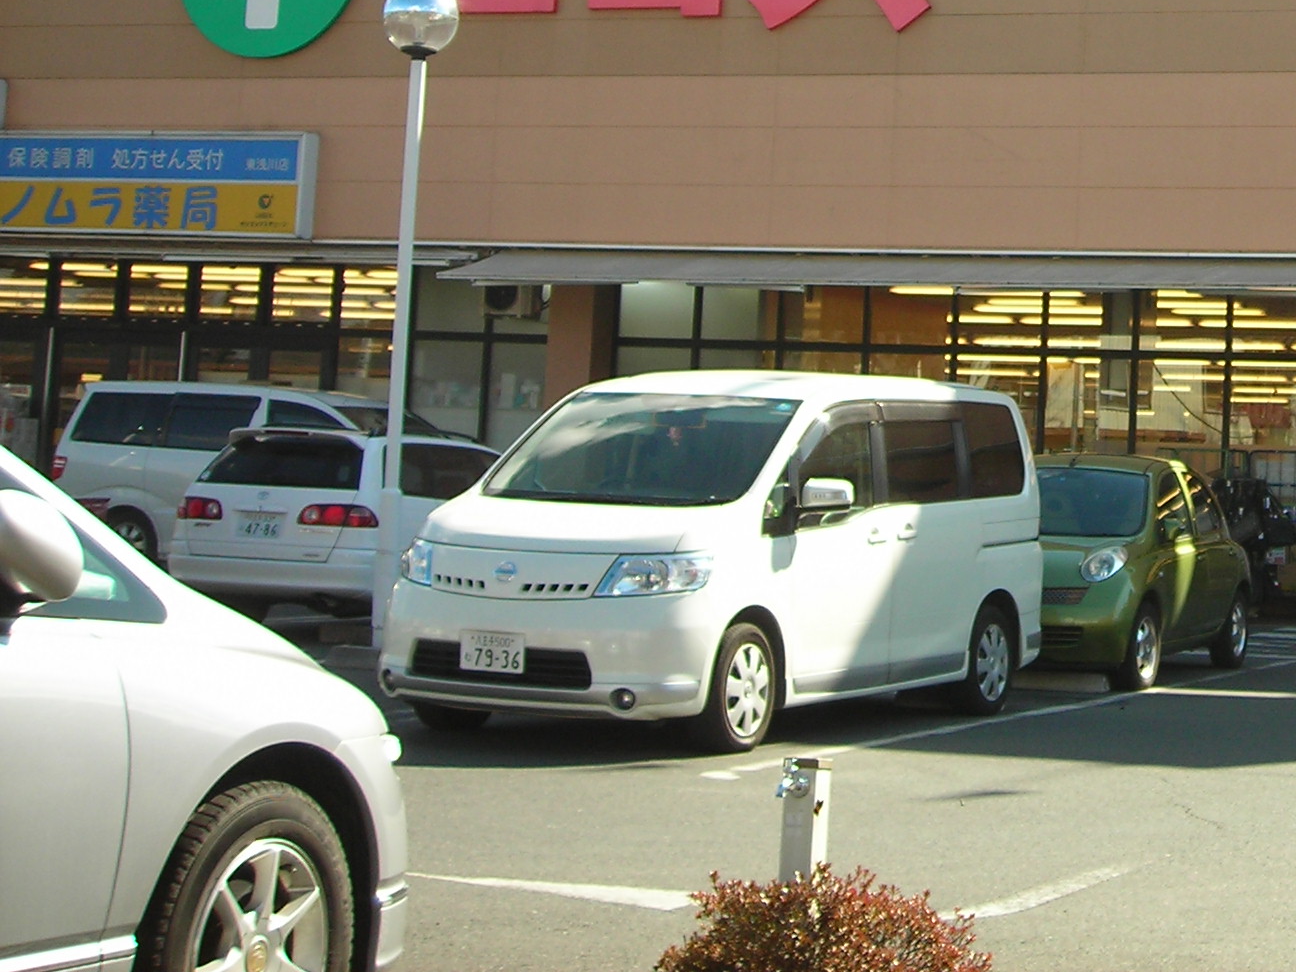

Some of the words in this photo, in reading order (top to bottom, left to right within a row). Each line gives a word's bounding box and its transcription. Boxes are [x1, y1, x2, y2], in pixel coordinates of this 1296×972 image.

[7, 147, 94, 168] 保険調剤
[111, 148, 224, 171] 処方せん受付
[474, 648, 520, 670] 79-36
